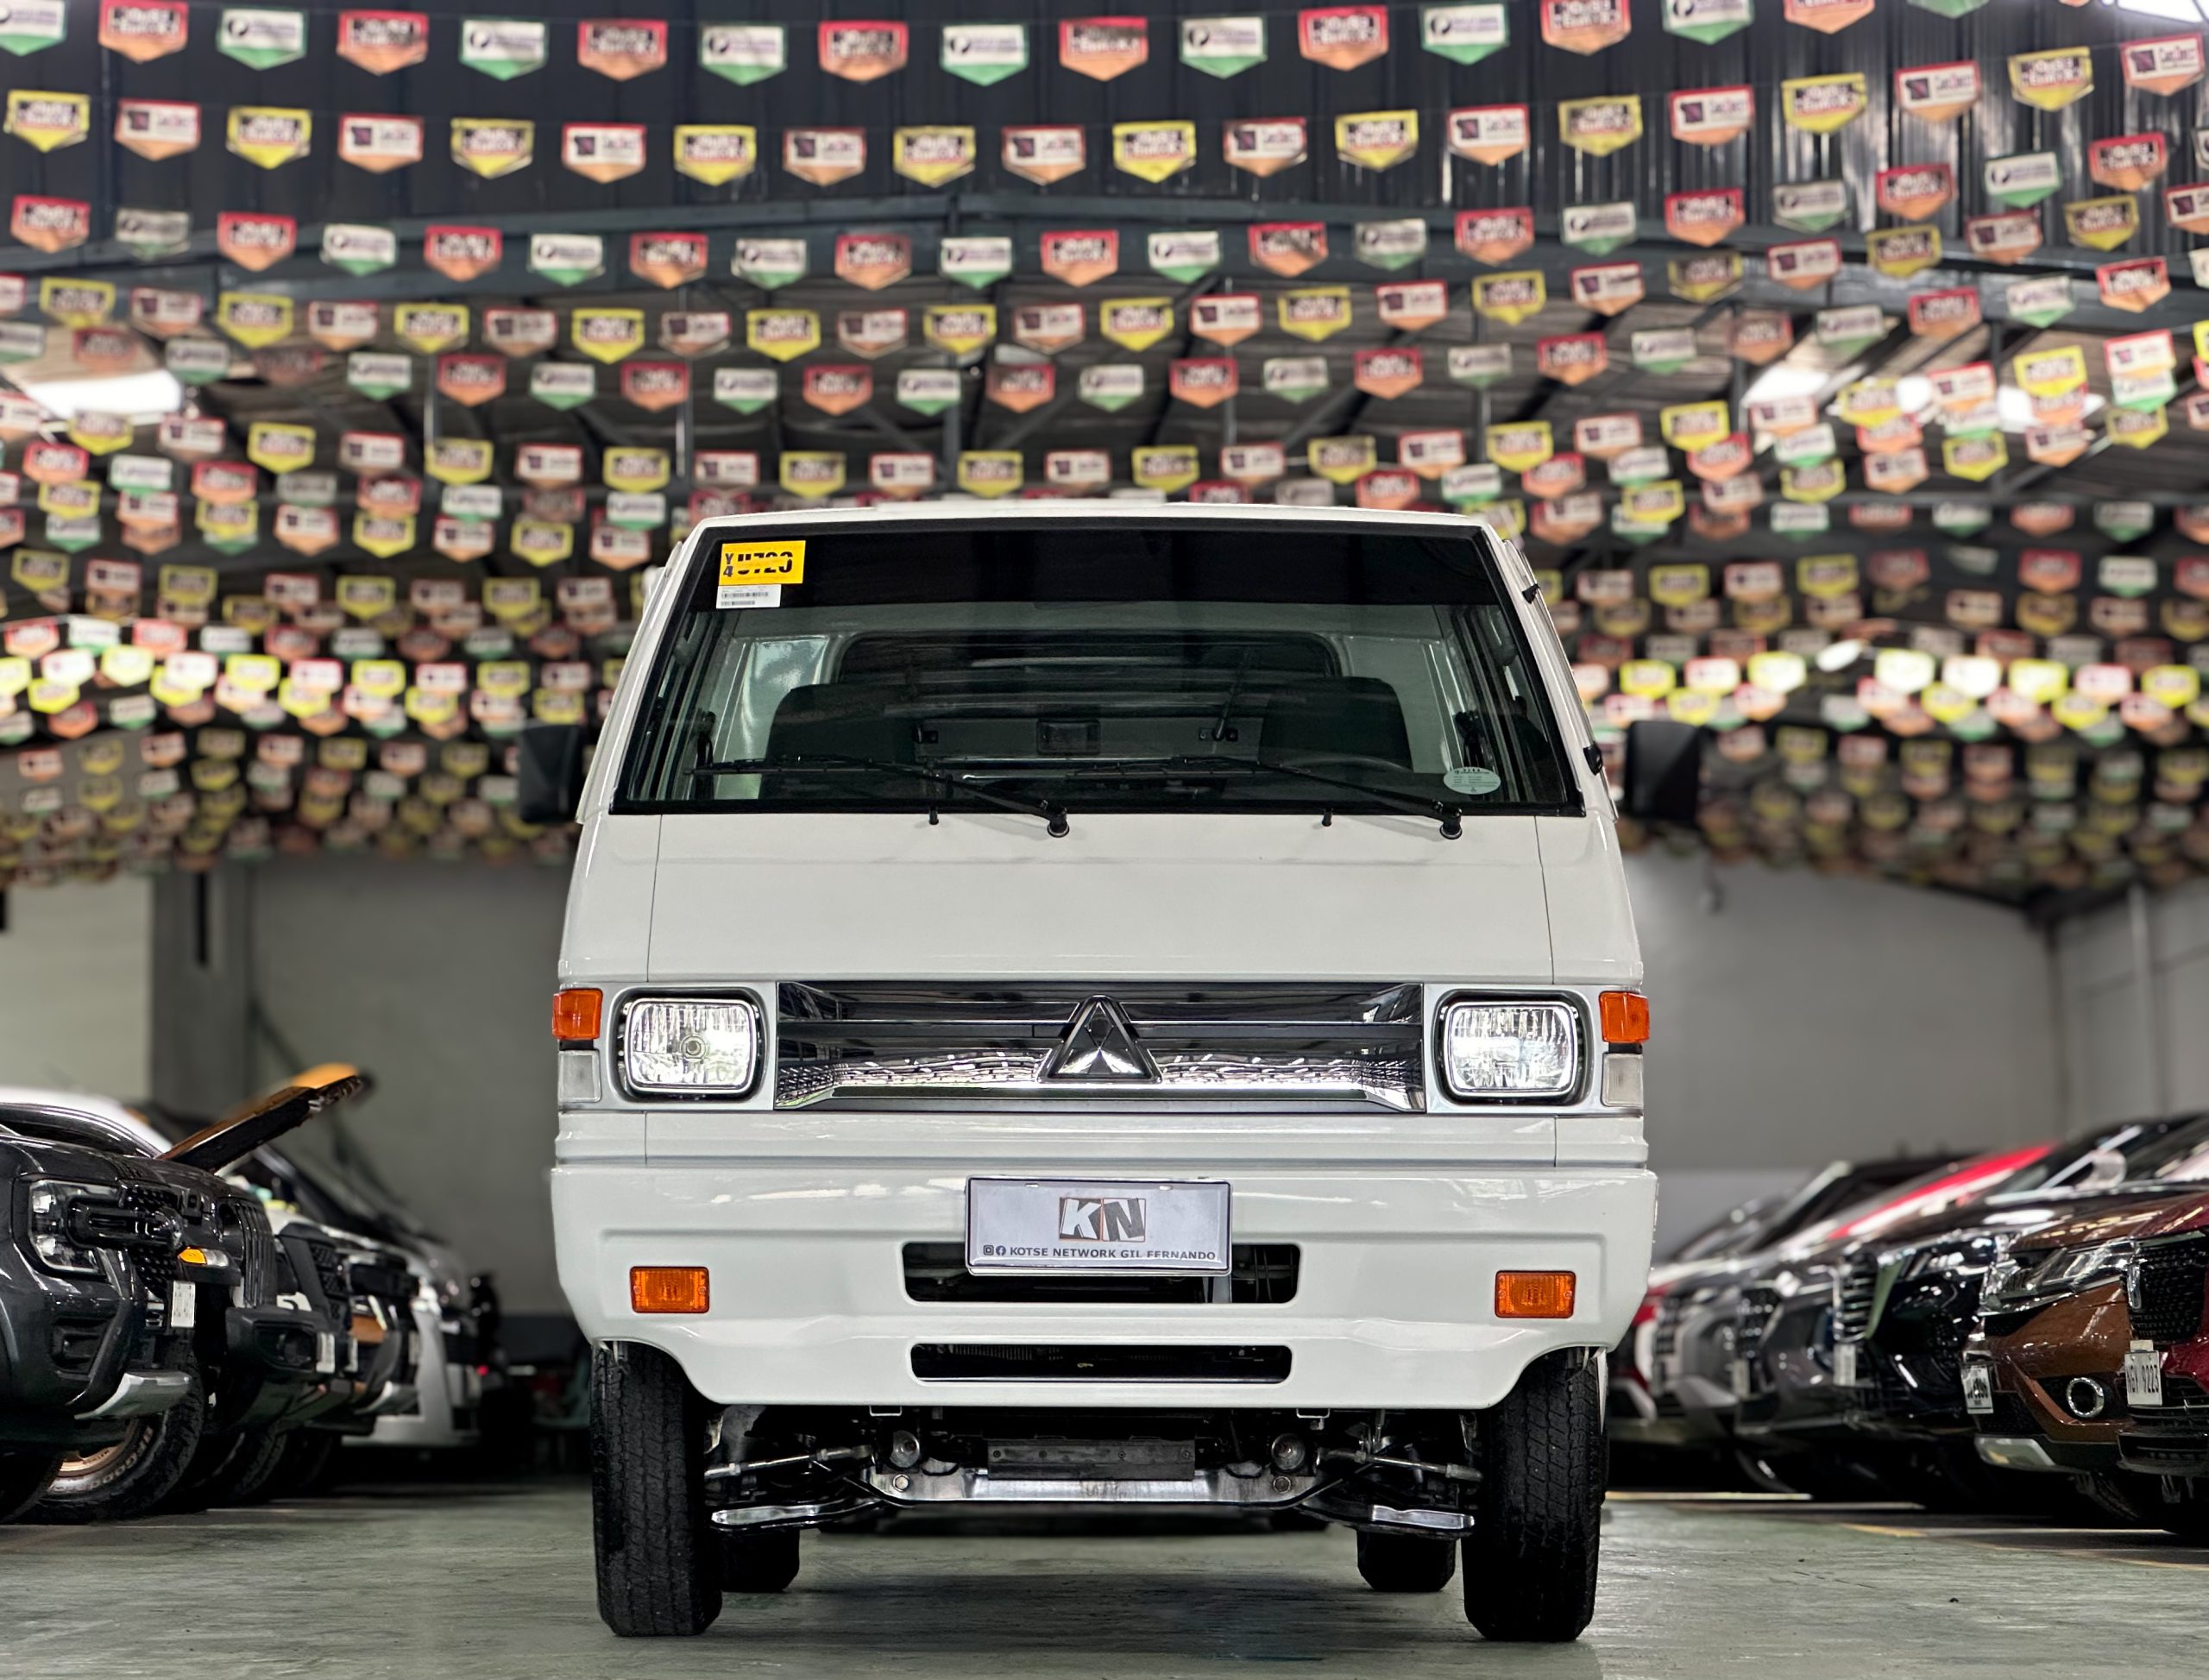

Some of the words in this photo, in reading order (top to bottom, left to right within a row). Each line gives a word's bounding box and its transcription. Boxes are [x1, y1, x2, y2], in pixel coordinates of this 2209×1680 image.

[1060, 1198, 1146, 1242] KN
[1010, 1247, 1048, 1256] KOTSE
[1053, 1248, 1117, 1258] NETWORK
[1120, 1249, 1142, 1258] GIL
[1147, 1250, 1216, 1260] FERNANDO
